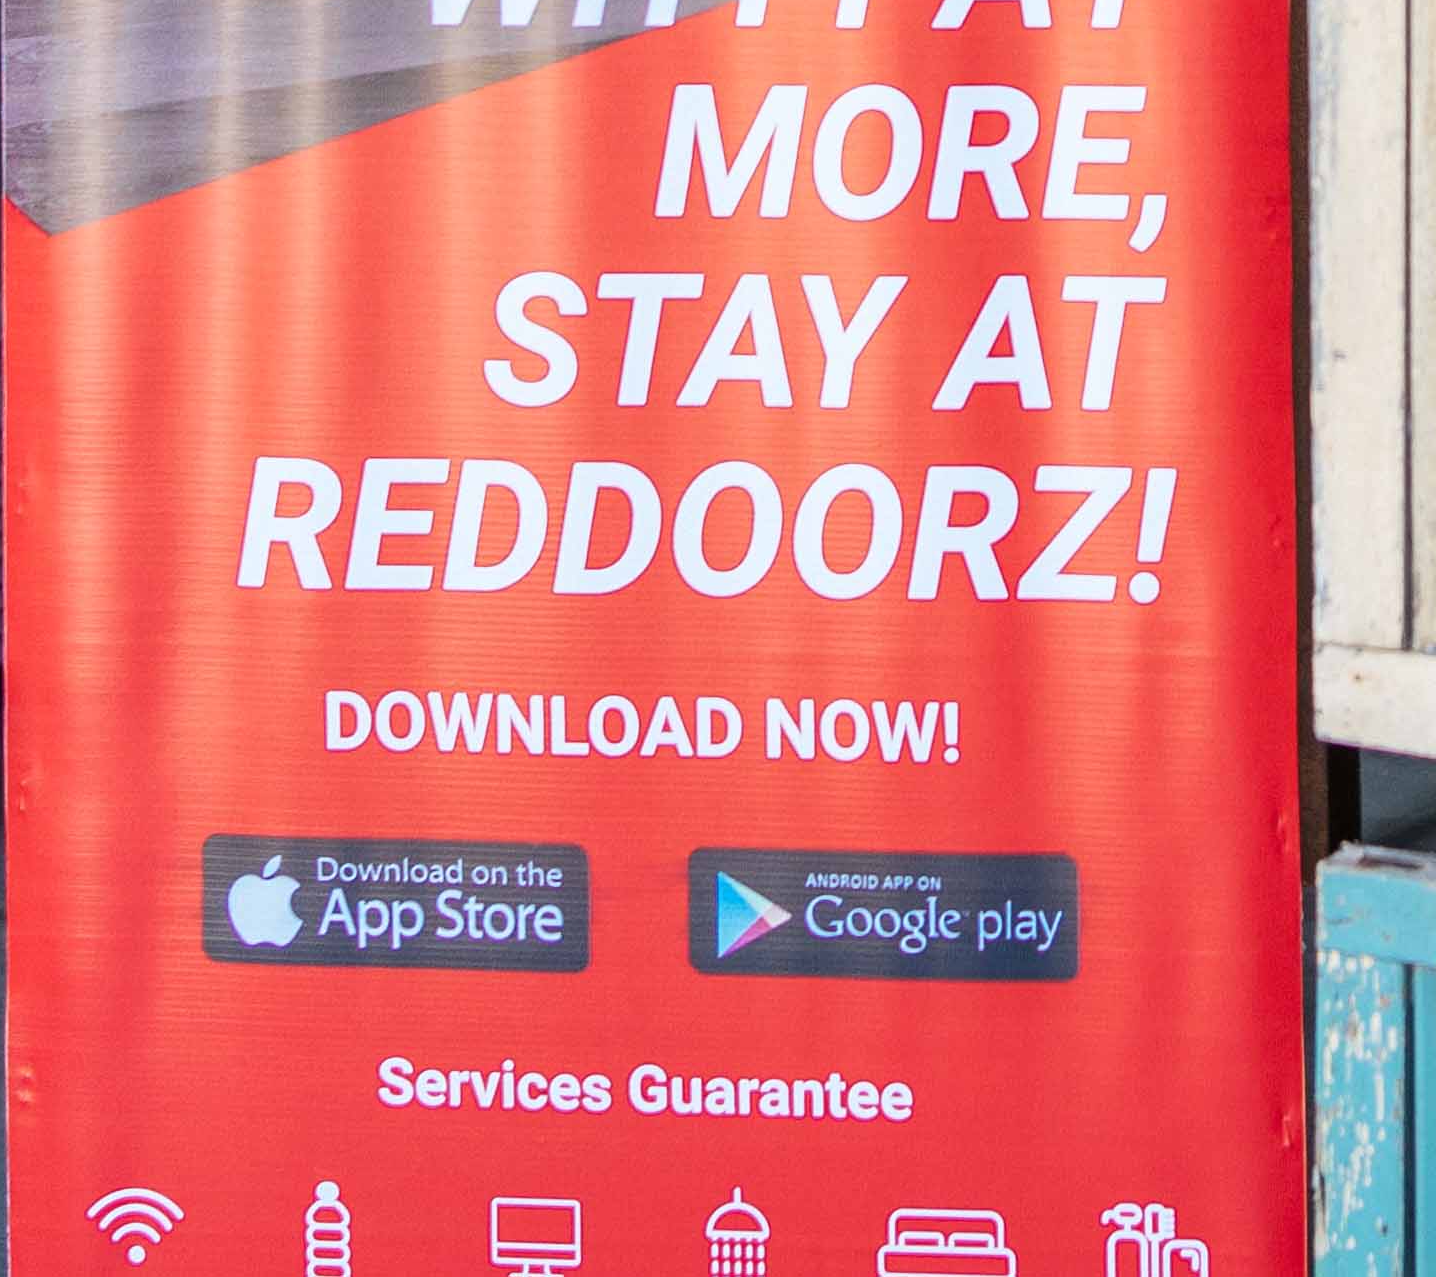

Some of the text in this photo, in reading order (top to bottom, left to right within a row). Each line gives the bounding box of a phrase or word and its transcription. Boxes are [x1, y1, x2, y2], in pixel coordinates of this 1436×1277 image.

[653, 83, 1169, 253] MORE,
[482, 270, 1169, 412] STAY AT
[235, 455, 1179, 605] REDDOORZ!
[325, 689, 962, 764] DOWNLOAD NOW!
[316, 855, 564, 888] Download on the
[804, 872, 942, 891] ANDROID APP ON
[316, 887, 564, 950] App Store
[804, 894, 1064, 954] Google play
[377, 1056, 915, 1122] Services Guarantee
